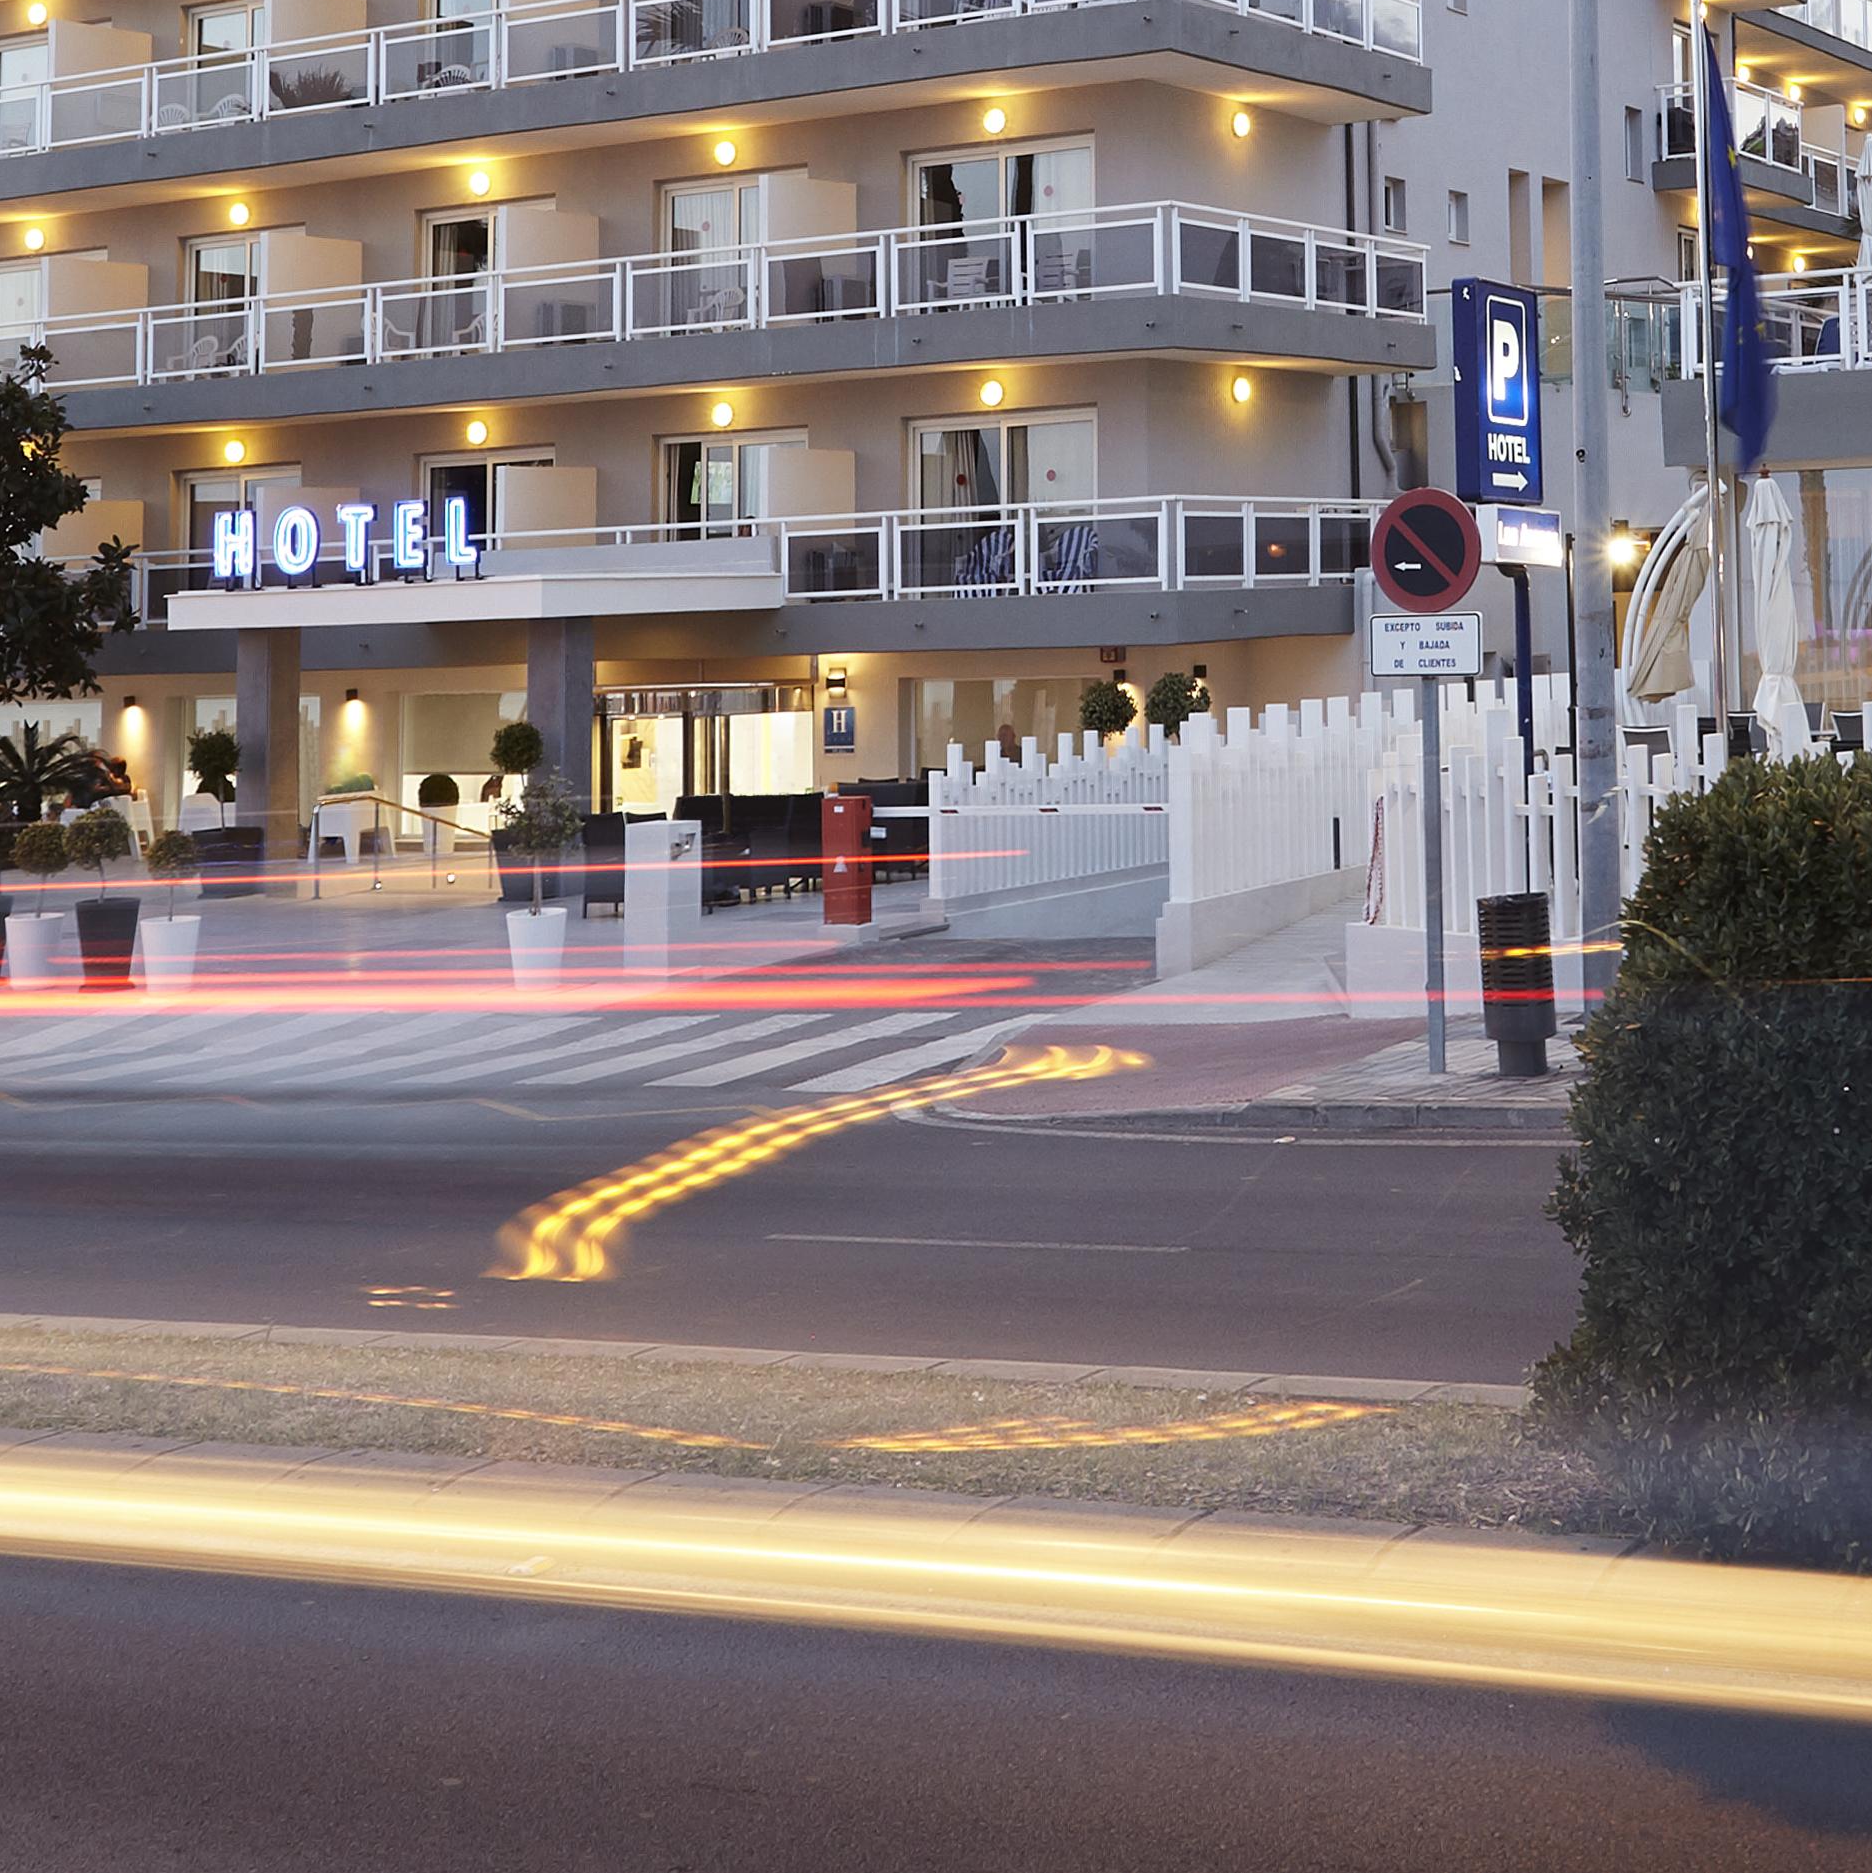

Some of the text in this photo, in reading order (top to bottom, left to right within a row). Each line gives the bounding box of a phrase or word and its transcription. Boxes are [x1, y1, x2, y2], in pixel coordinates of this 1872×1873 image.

[1492, 318, 1520, 401] P
[1487, 432, 1531, 465] HOTEL
[214, 496, 479, 578] HOTEL
[1384, 621, 1464, 632] EXCEPTO SUBIDA
[1400, 640, 1450, 650] Y BAJADA
[1393, 658, 1456, 668] DE CLIENTES
[831, 709, 847, 733] H
